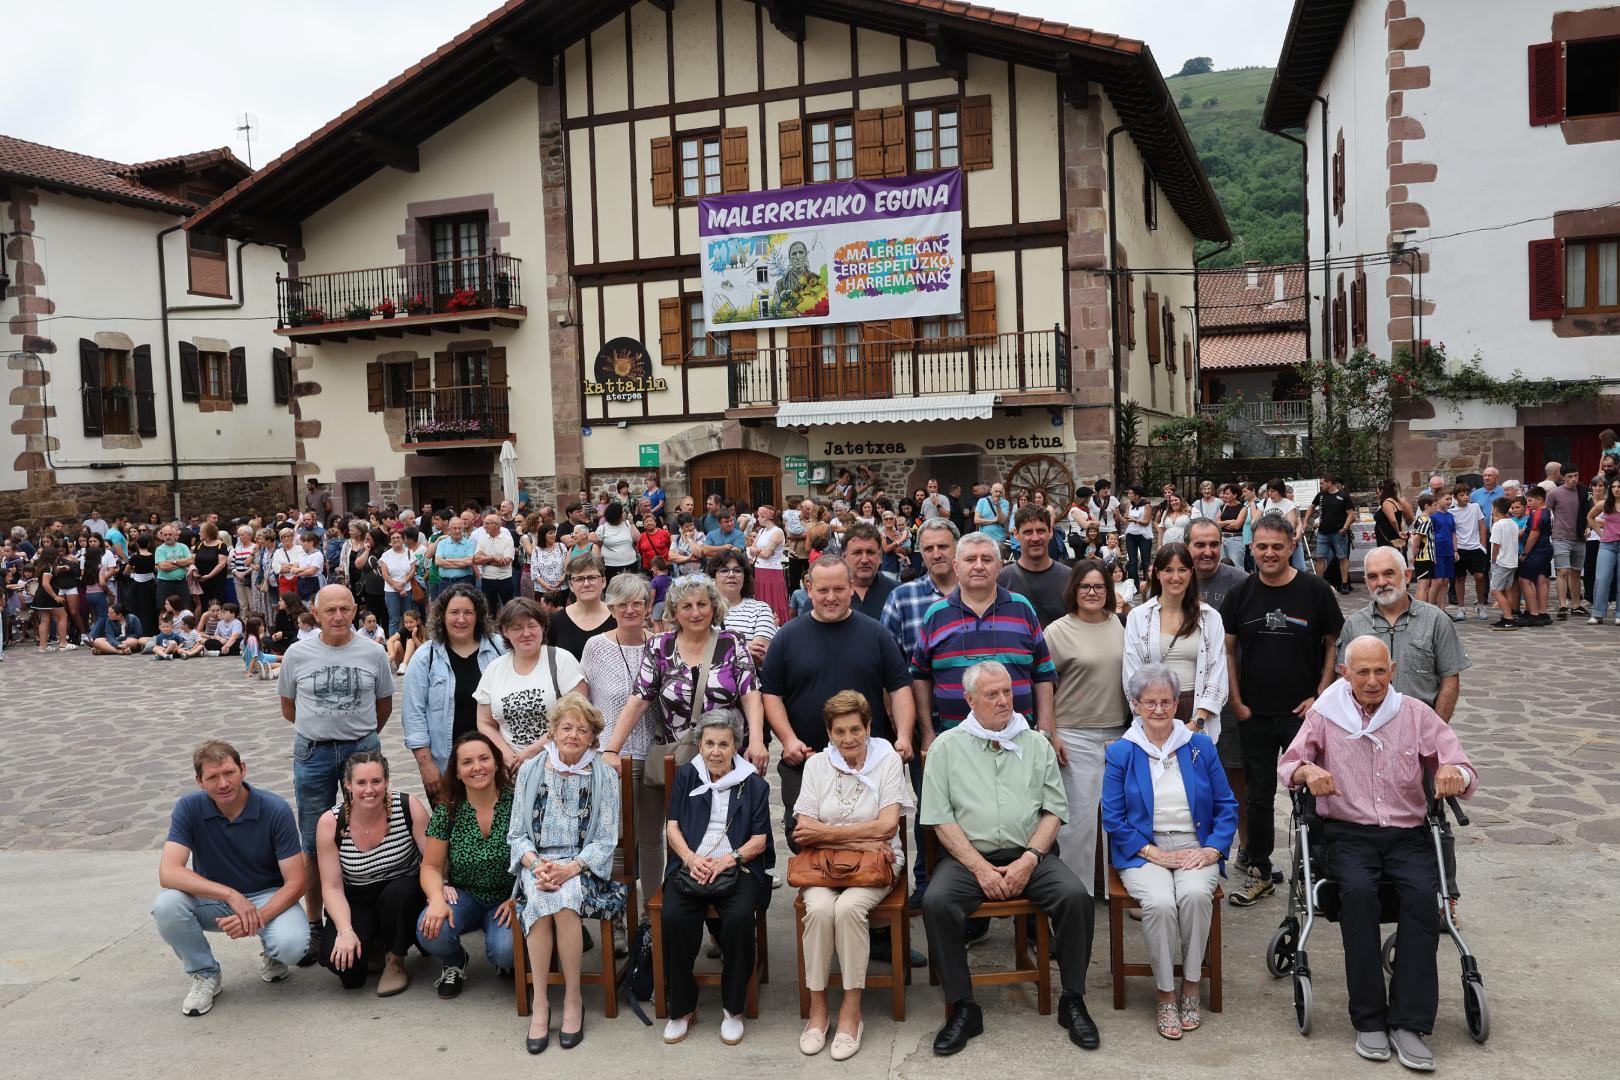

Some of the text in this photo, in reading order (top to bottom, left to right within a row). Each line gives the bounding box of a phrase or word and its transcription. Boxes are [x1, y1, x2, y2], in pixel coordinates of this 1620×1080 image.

[707, 184, 949, 229] MALERREKAKO EGUNA
[846, 240, 943, 261] MALERREKAN
[841, 255, 951, 276] ERRESPETUZKO
[845, 270, 946, 291] HARREMANAK
[584, 376, 667, 395] kattalin
[606, 392, 643, 402] aterpea
[824, 441, 906, 456] Jatetxea
[985, 433, 1063, 450] ostatua
